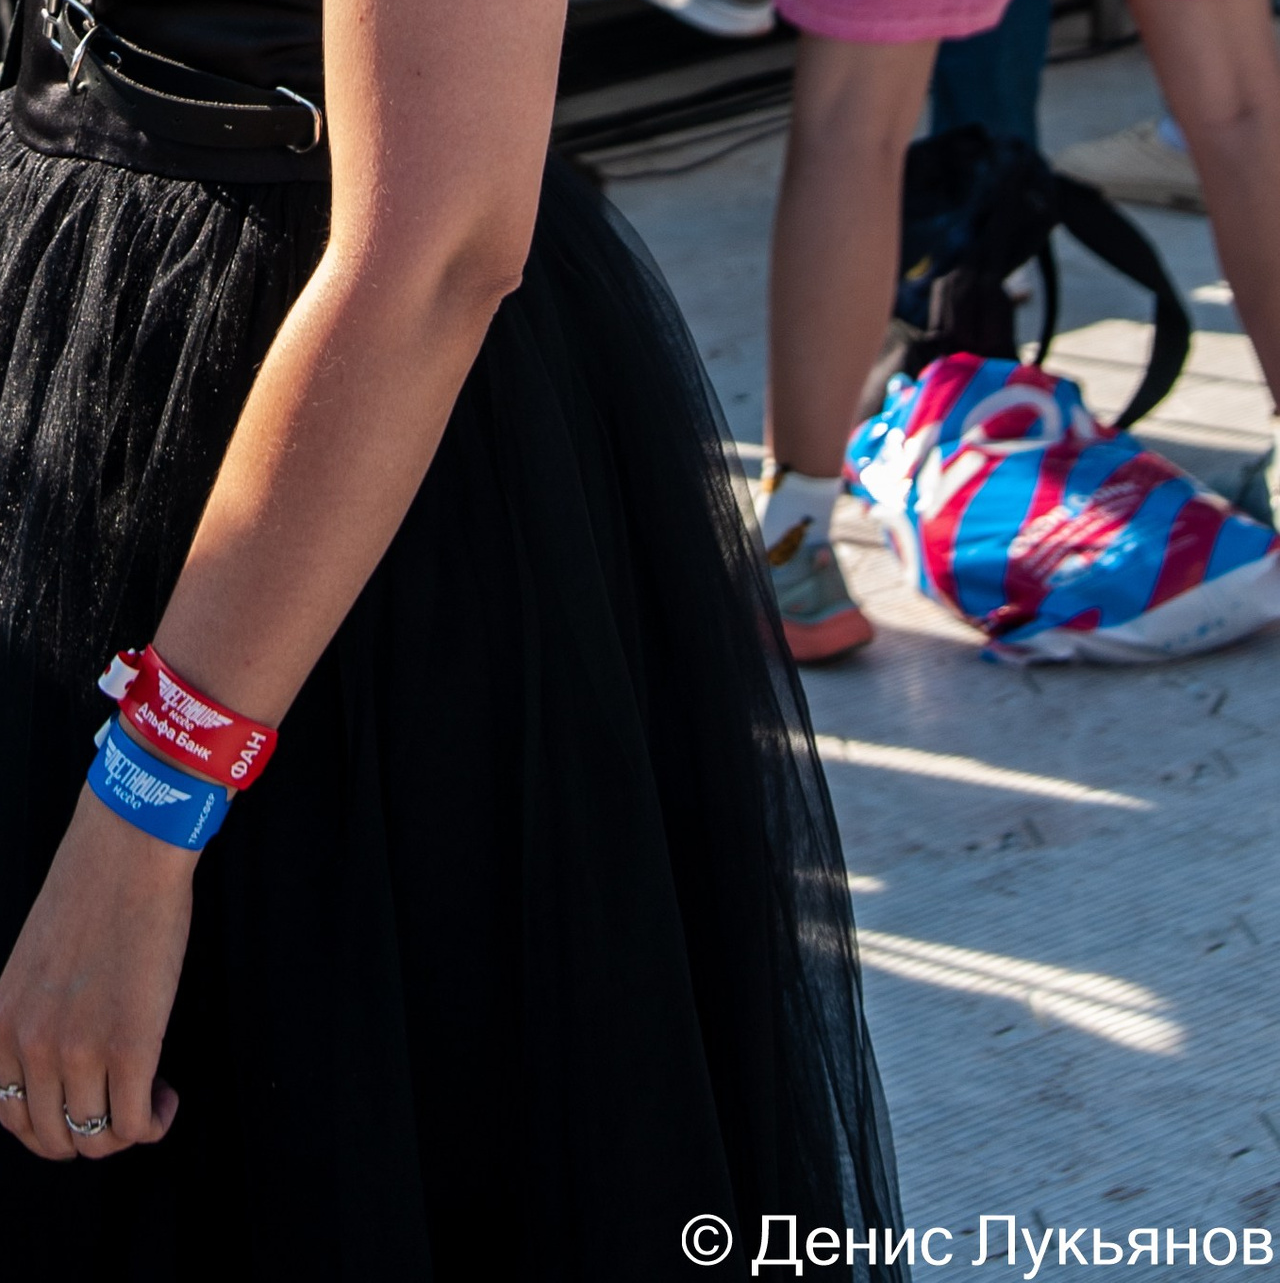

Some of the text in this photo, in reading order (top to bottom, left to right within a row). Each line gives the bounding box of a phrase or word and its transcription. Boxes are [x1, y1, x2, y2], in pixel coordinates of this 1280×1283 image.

[162, 682, 218, 730] ЛЕСТНИЦА
[169, 709, 195, 732] небо
[138, 702, 212, 761] Альфа Банк
[106, 748, 171, 806] ЛЕСТНИЦА
[230, 732, 267, 780] ФАН
[113, 784, 142, 810] небо
[188, 792, 215, 844] ТРАНСФЕР
